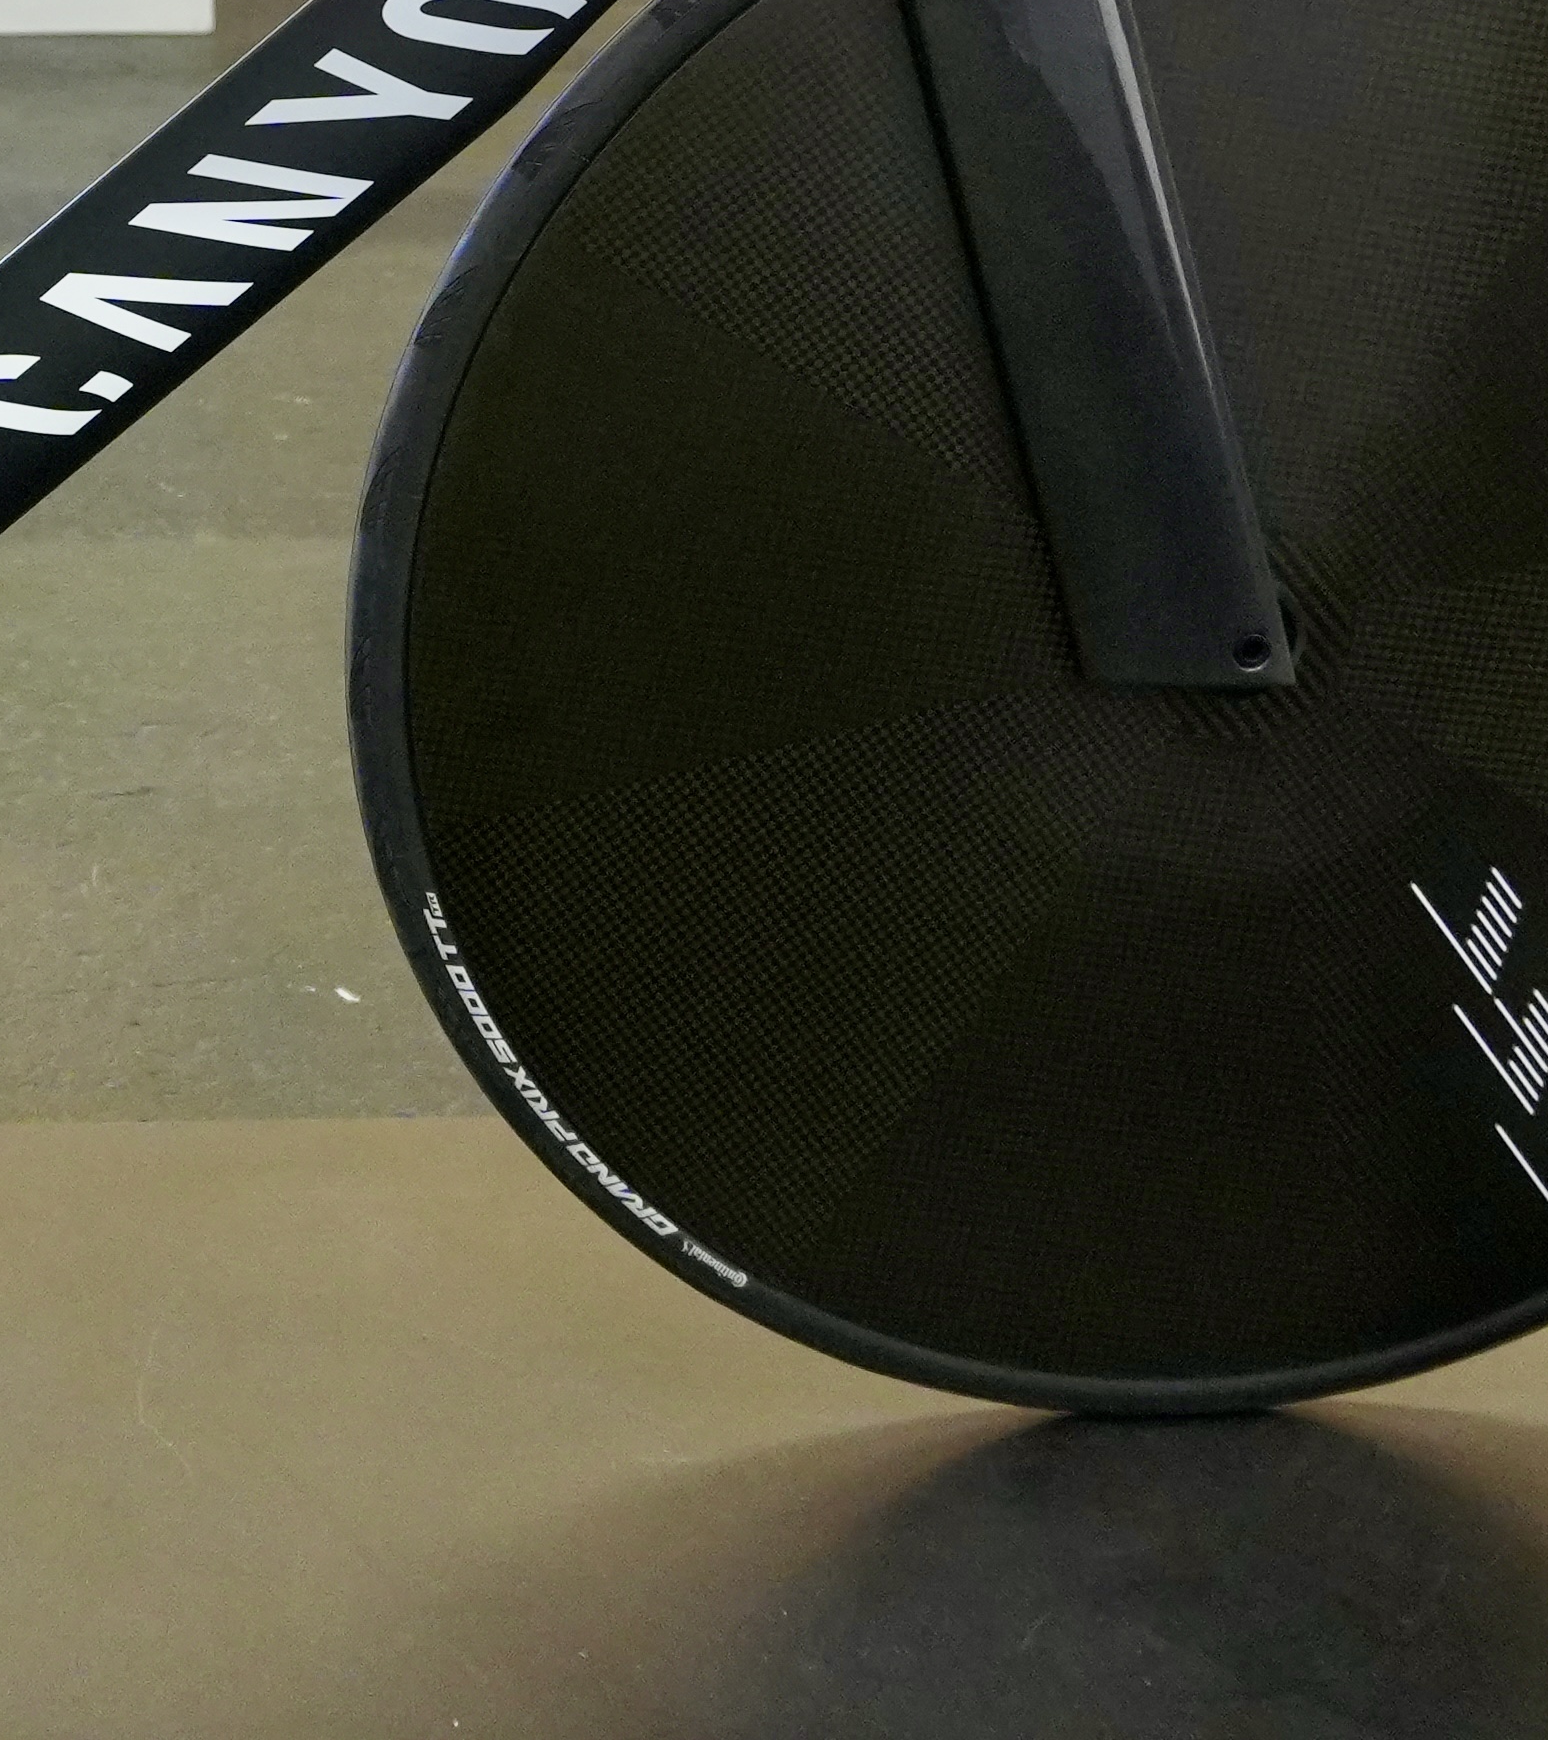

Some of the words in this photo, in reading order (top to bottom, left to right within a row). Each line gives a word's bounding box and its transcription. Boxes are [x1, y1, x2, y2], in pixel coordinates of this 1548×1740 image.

[422, 907, 459, 961] TT
[445, 963, 519, 1064] 5000
[504, 1065, 580, 1143] PRIX
[565, 1141, 680, 1237] GRAND
[689, 1243, 749, 1289] Continental
